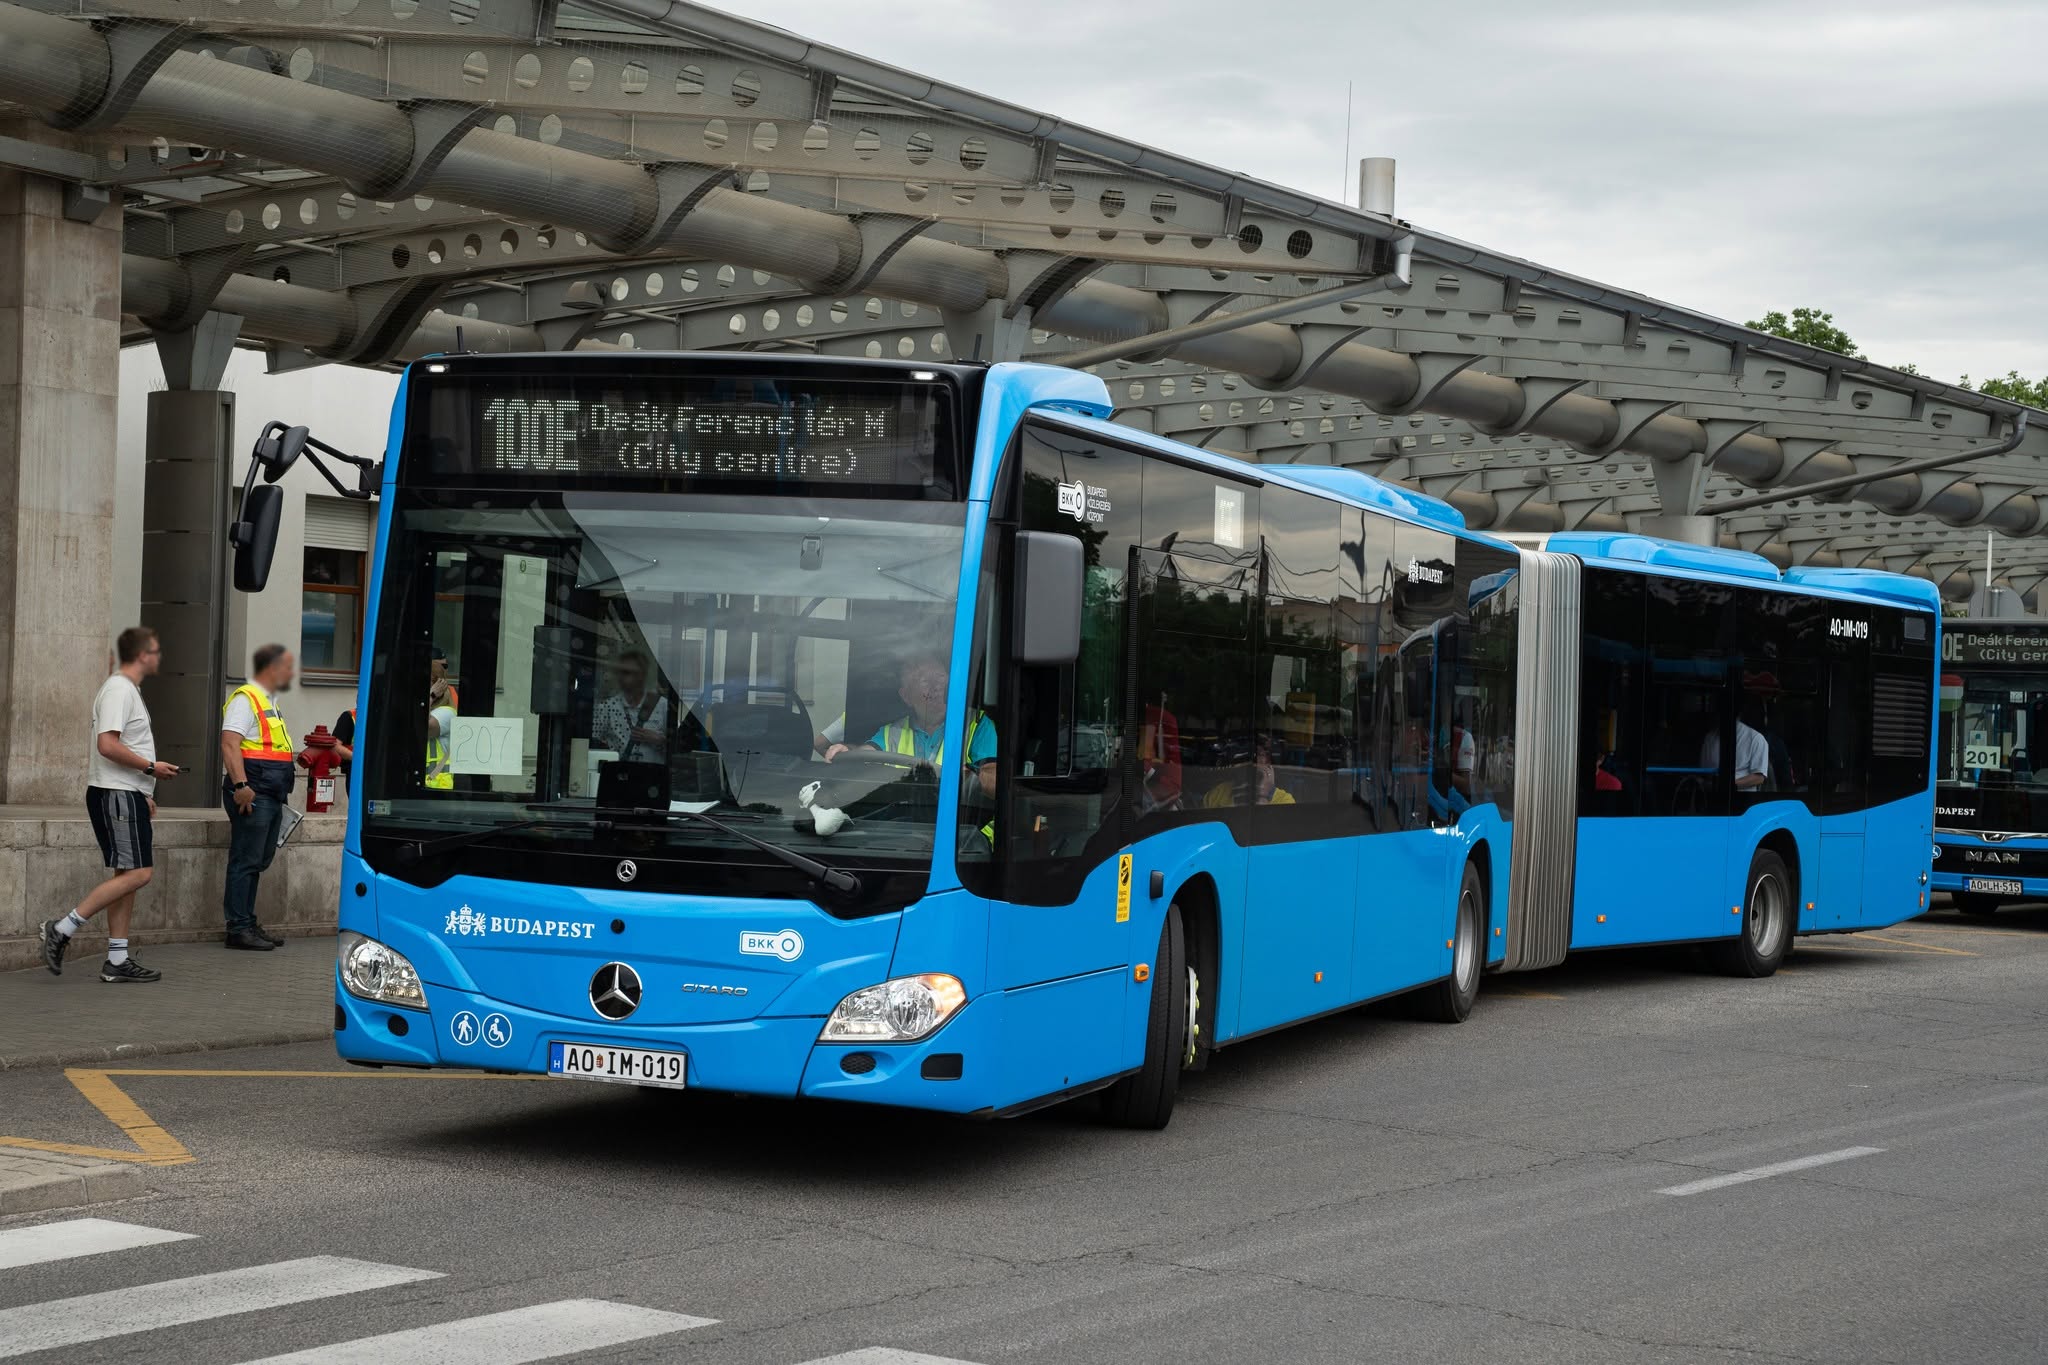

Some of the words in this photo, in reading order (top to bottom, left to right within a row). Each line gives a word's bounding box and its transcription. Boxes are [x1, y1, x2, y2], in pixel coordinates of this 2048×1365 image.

[591, 402, 668, 433] Deák
[677, 406, 793, 435] Ferenc
[806, 406, 855, 437] tér
[864, 410, 884, 438] M
[484, 397, 580, 471] 100E
[618, 441, 700, 474] (City
[714, 446, 857, 476] centre)
[1061, 492, 1074, 506] BKK
[1829, 617, 1868, 639] AO-IM-019
[1968, 633, 2003, 646] Deák
[1980, 649, 2017, 662] (City
[456, 724, 513, 767] 207
[1966, 750, 1998, 766] 201
[1965, 850, 2020, 864] MAN
[490, 916, 596, 940] BUDAPEST
[747, 936, 776, 951] BKK
[681, 982, 749, 997] CITARO
